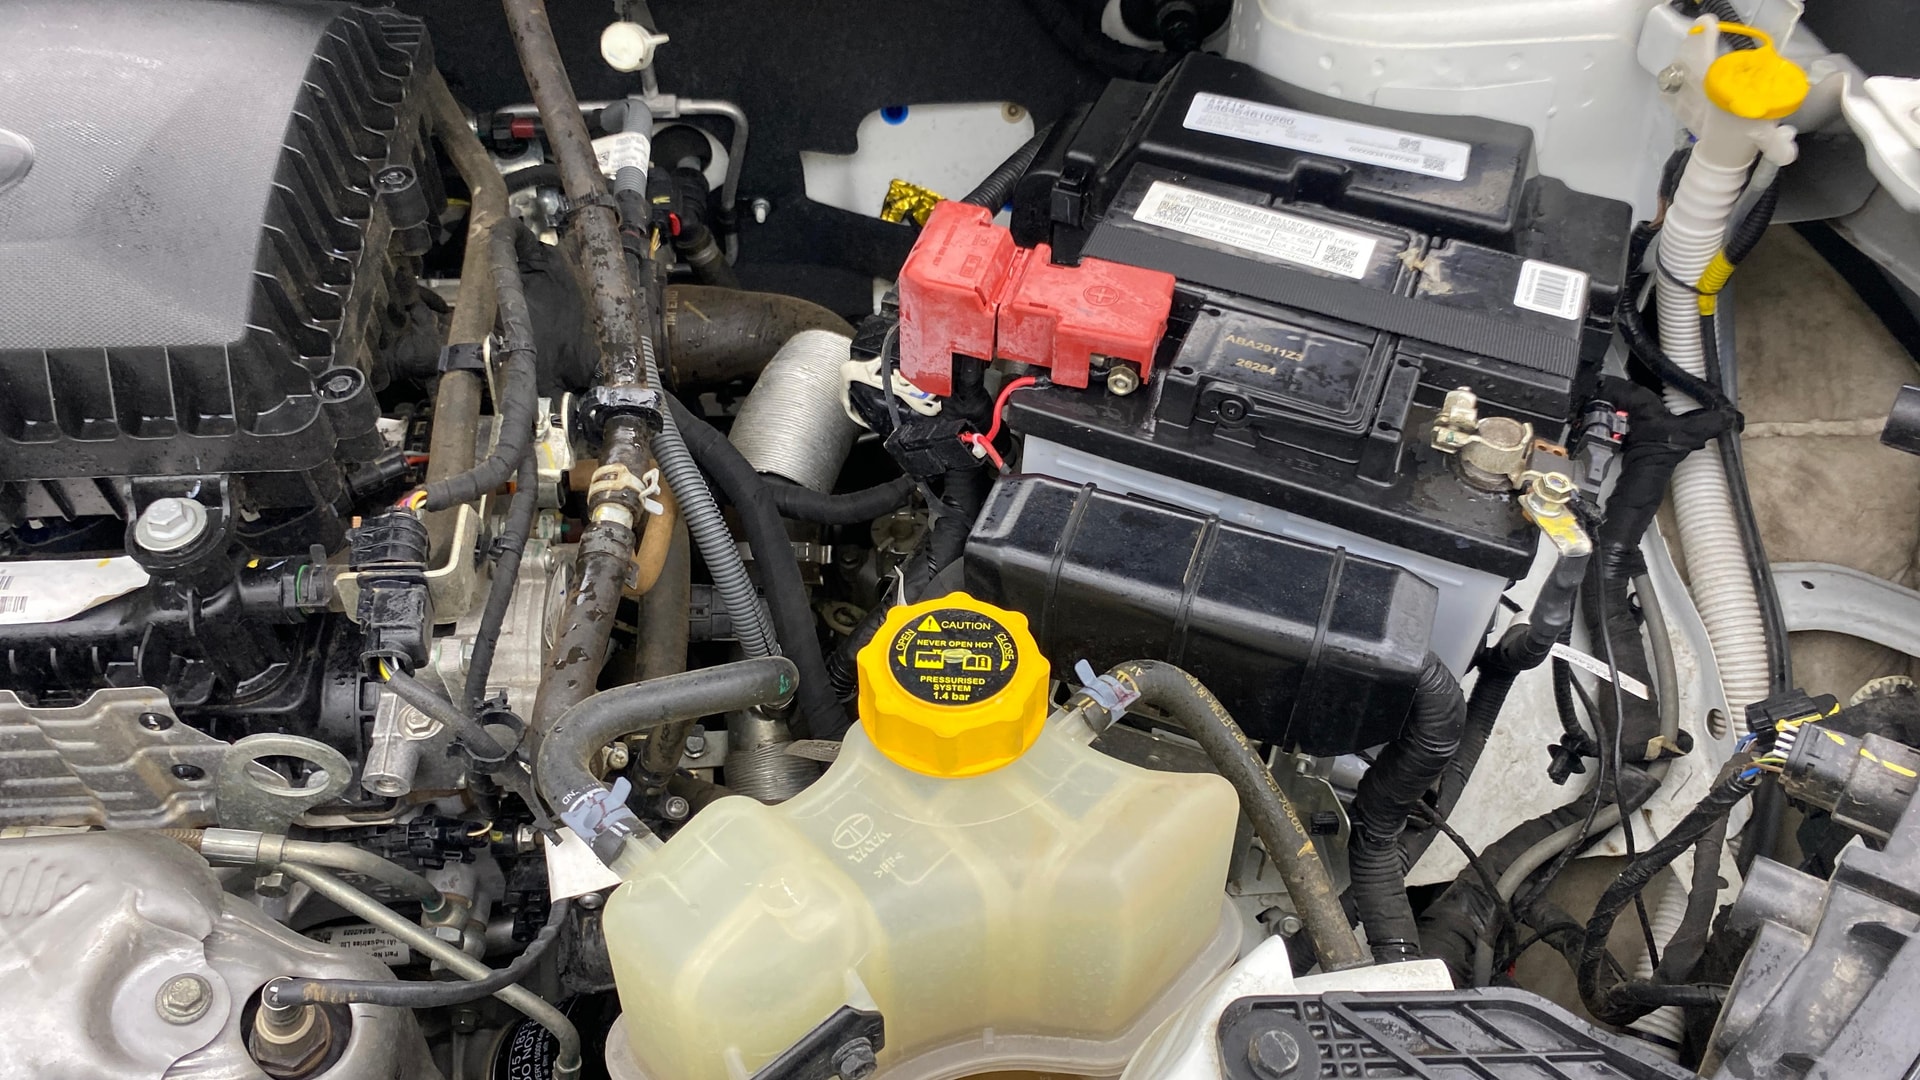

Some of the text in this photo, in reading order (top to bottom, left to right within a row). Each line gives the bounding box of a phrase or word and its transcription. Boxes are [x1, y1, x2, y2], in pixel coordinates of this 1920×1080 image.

[1224, 334, 1304, 362] ABA2911Z3
[941, 620, 991, 630] CAUTION
[895, 628, 915, 651] OPEN
[917, 639, 994, 649] NEVER OPEN HOT
[998, 632, 1015, 661] CLOSE
[920, 675, 986, 685] PRESSURISED
[933, 684, 972, 692] SYSTEM
[933, 692, 970, 701] 1.4 bar
[522, 1029, 537, 1060] NOT
